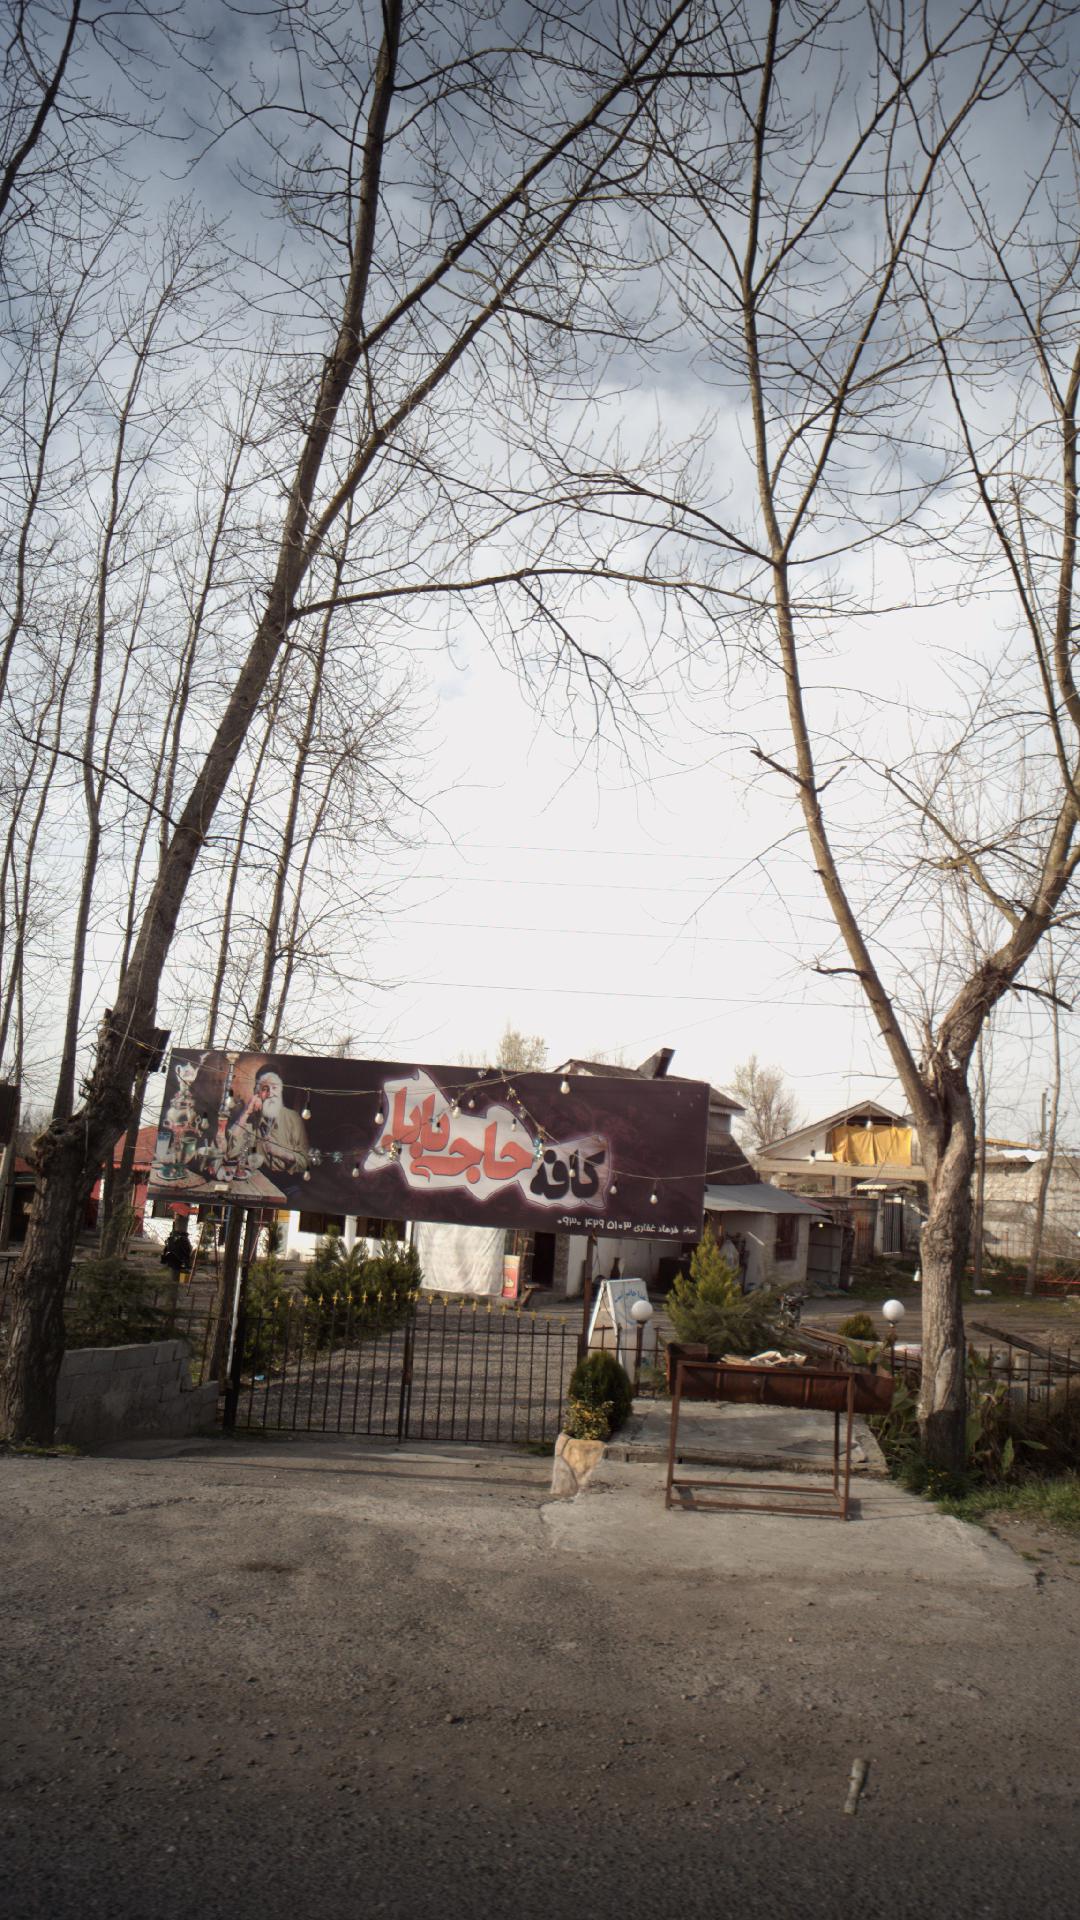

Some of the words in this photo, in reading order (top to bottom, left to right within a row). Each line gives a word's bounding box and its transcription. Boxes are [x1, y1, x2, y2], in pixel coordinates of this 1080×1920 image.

[381, 1086, 450, 1159] بابا
[410, 1121, 534, 1184] حاجی
[530, 1149, 606, 1199] کافه
